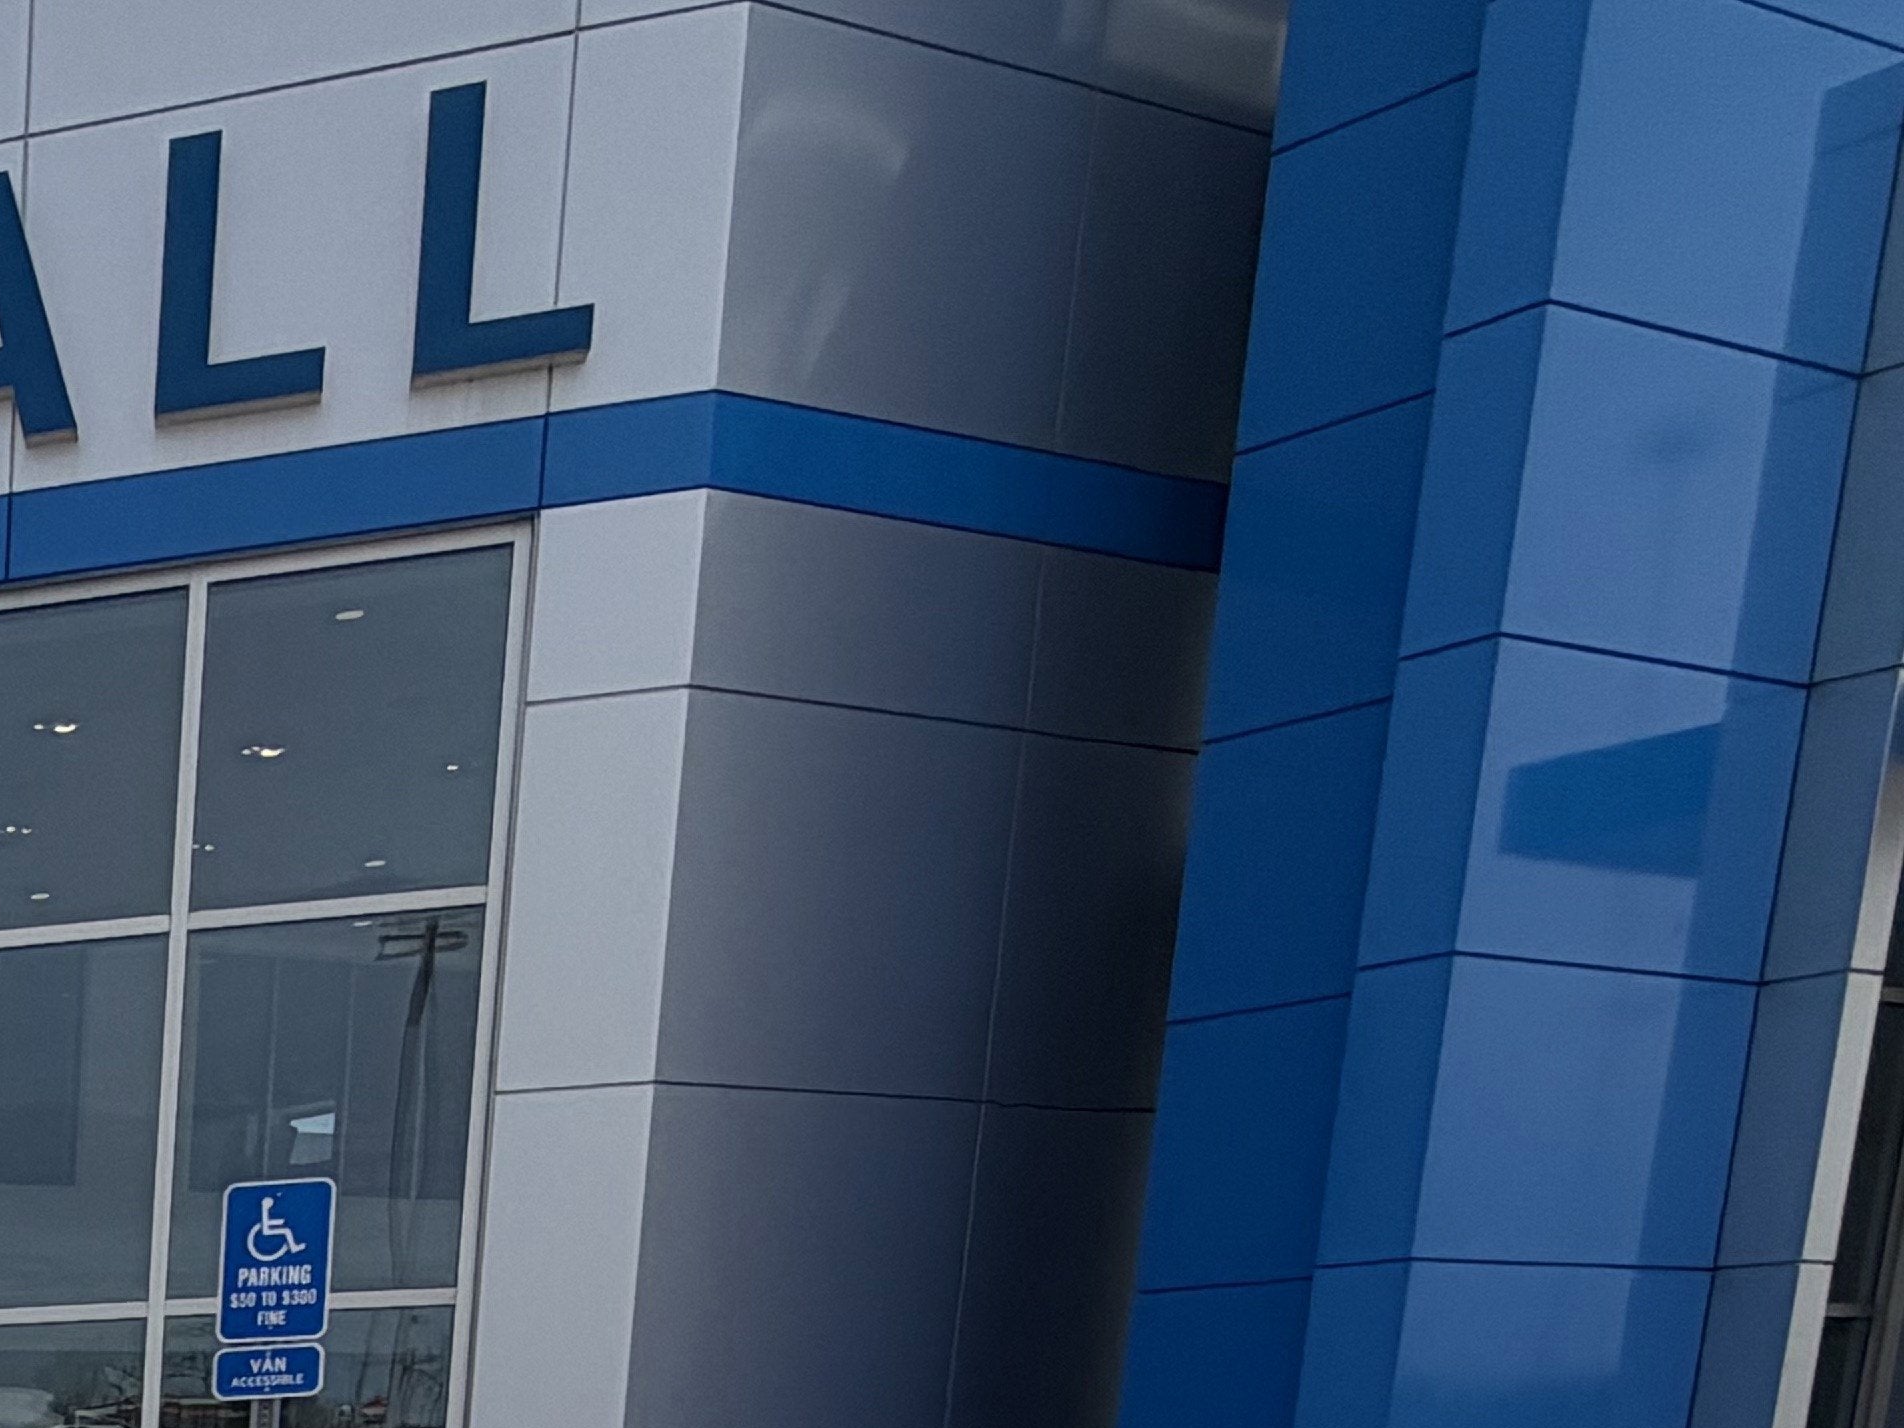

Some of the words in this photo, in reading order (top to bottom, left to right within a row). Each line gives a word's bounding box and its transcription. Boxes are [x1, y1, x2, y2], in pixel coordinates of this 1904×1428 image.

[237, 1264, 313, 1288] PARKING
[230, 1292, 257, 1308] $50
[262, 1291, 277, 1306] TO
[282, 1288, 317, 1306] $300
[257, 1310, 287, 1326] FINE
[250, 1357, 287, 1373] VAN
[231, 1373, 304, 1388] ACCESSIBLE
